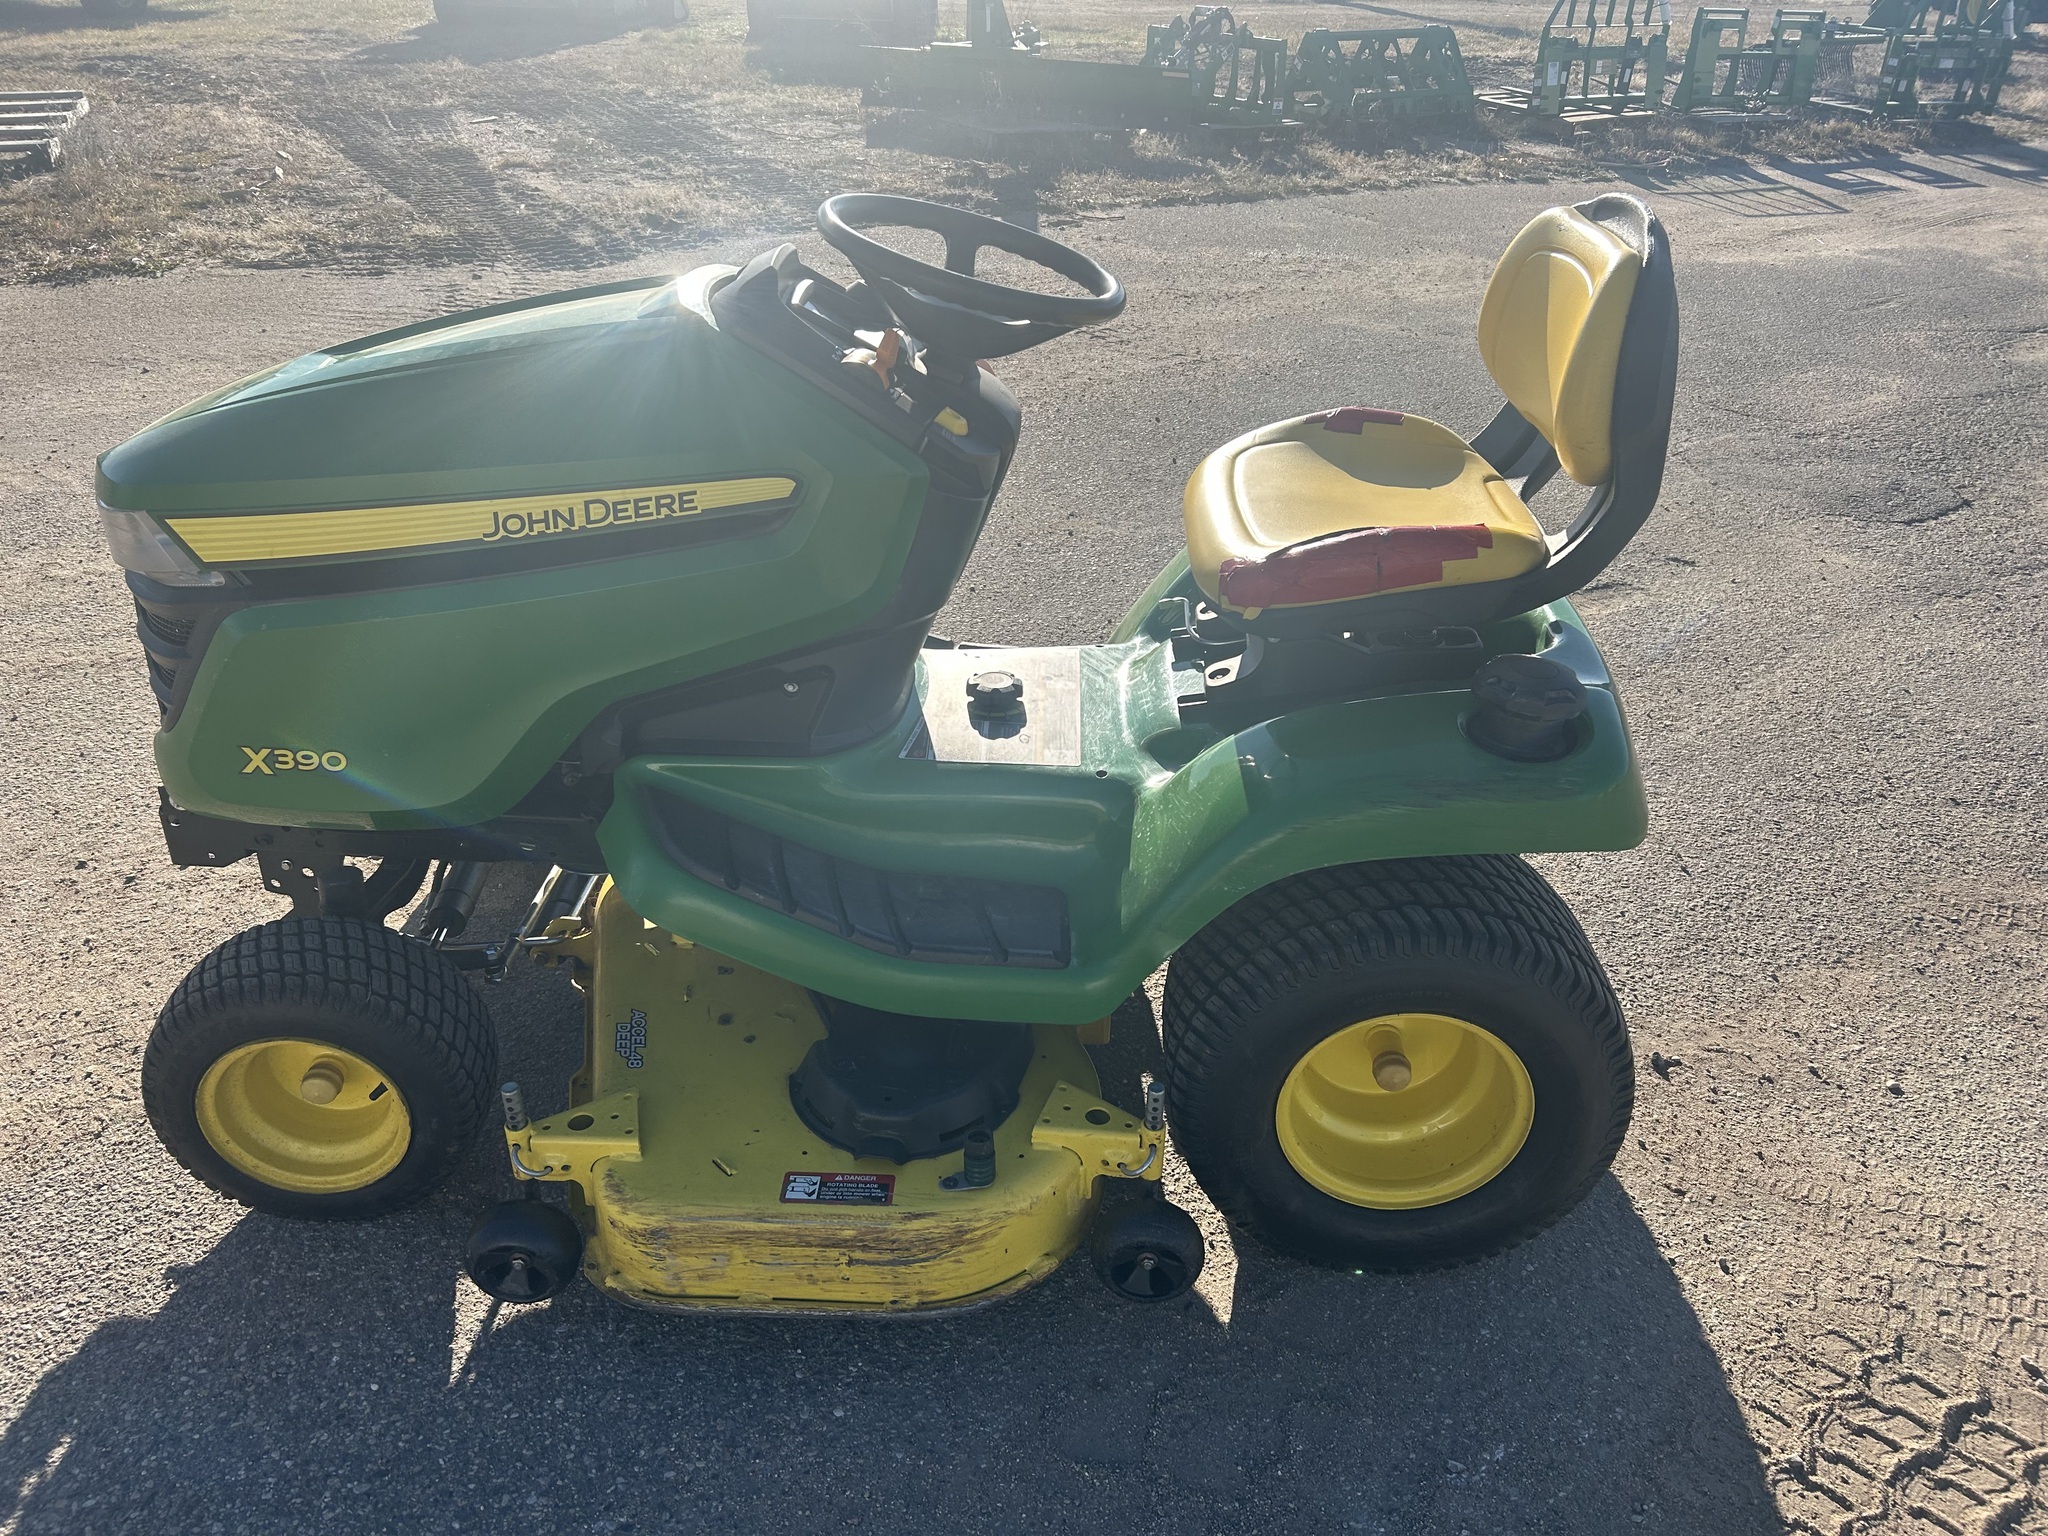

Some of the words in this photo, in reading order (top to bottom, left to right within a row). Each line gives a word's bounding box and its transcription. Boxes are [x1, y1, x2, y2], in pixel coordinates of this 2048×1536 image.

[482, 506, 577, 540] JOHN
[583, 490, 699, 528] DEERE
[240, 746, 348, 775] X390
[616, 1022, 630, 1058] DEEP
